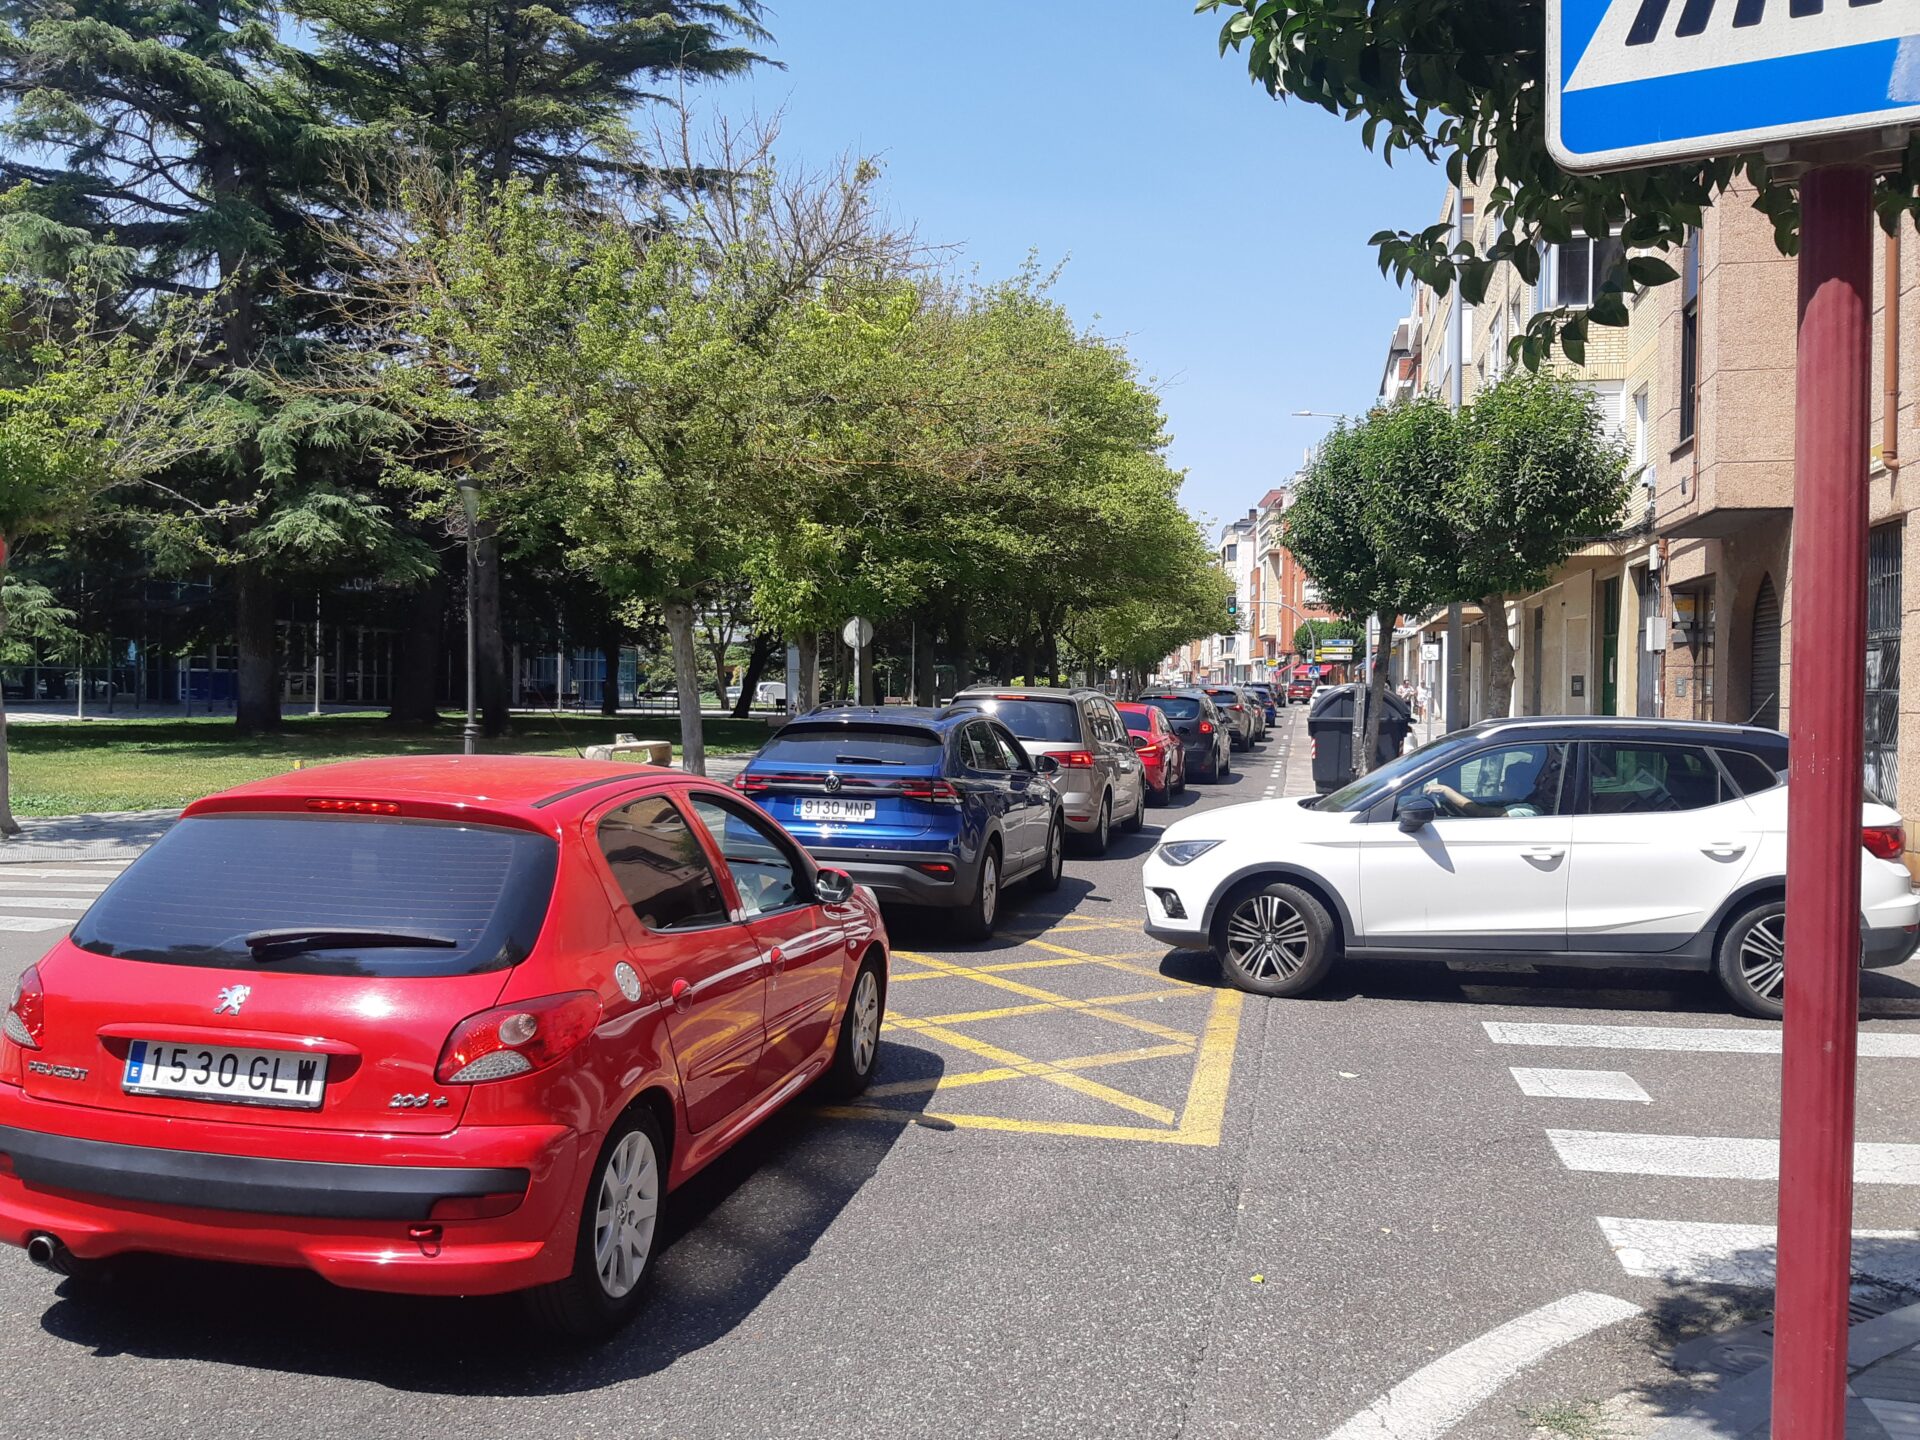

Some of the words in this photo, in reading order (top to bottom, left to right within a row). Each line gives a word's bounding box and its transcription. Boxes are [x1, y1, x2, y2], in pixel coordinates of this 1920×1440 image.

[805, 800, 840, 814] 9130
[845, 802, 872, 816] MNP
[28, 1060, 89, 1081] PEUGEOT
[152, 1047, 239, 1088] 1530
[248, 1056, 317, 1095] GLW
[388, 1093, 430, 1108] 206
